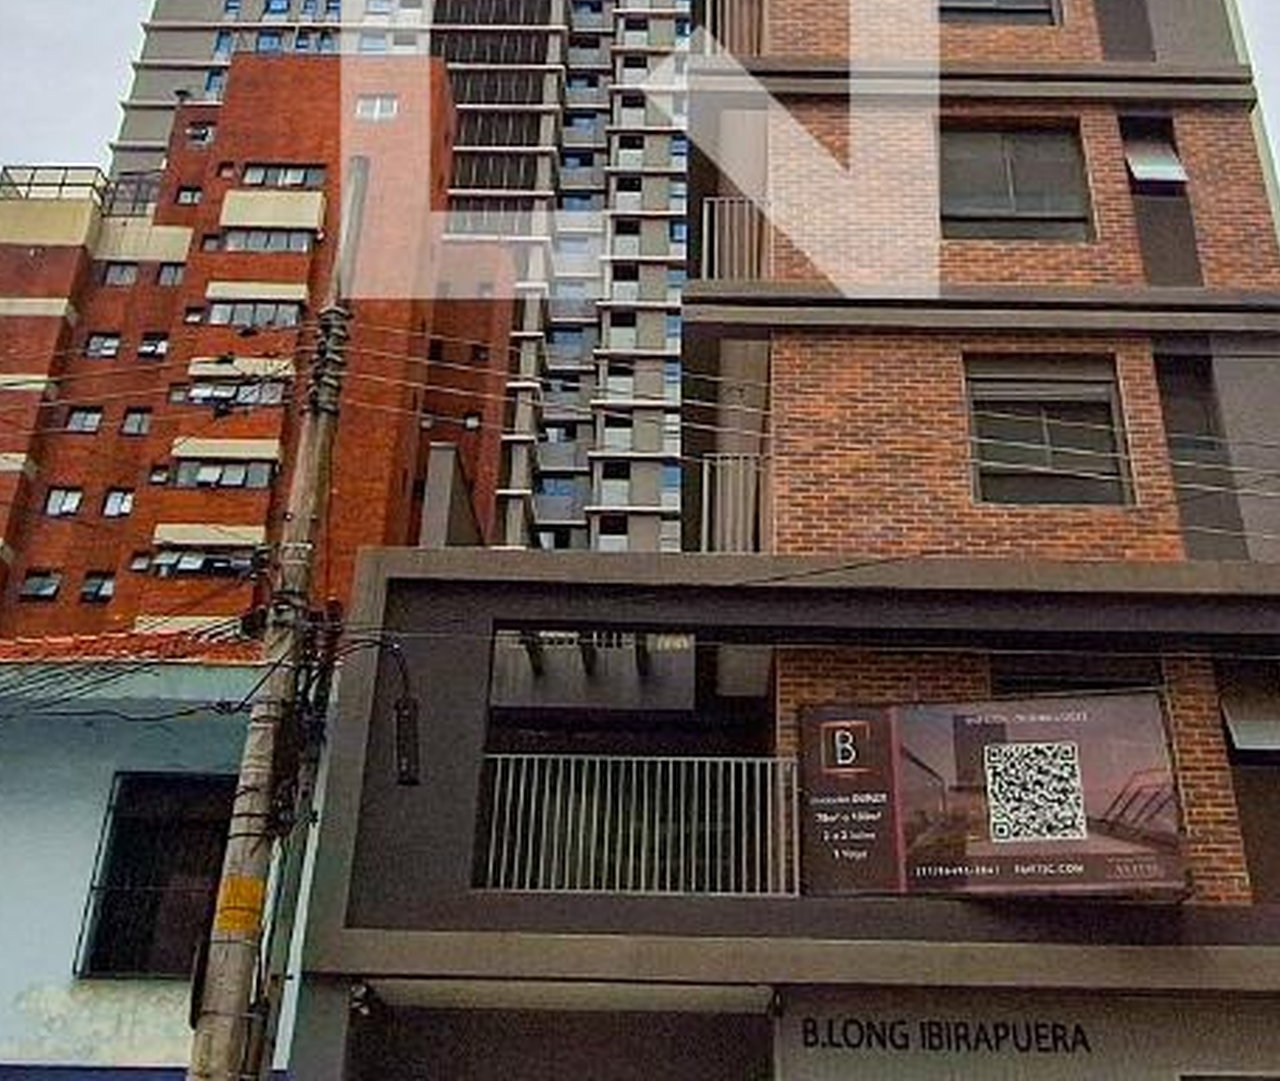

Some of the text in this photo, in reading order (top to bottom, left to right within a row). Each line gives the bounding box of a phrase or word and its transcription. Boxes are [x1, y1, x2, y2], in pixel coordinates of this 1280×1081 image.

[834, 729, 857, 765] B
[802, 1018, 1092, 1053] B.LONG IBIRAPUERA
